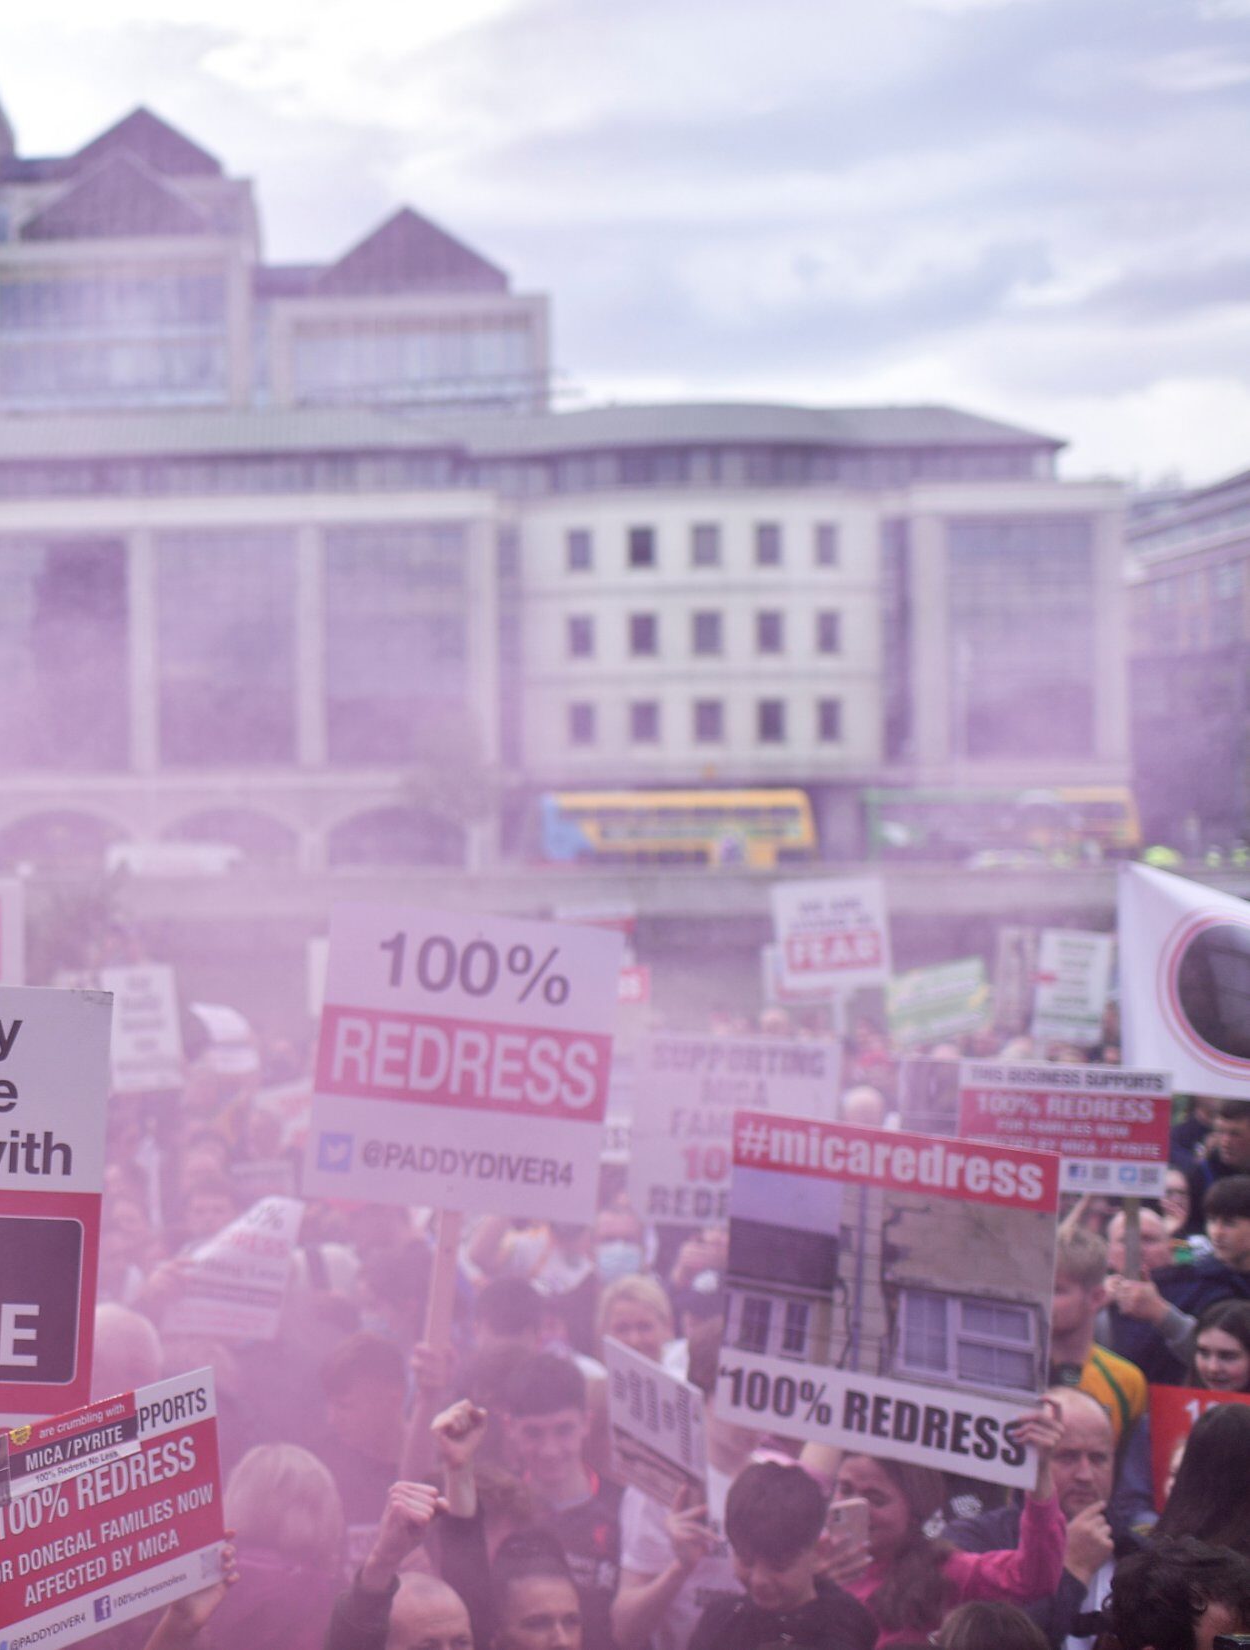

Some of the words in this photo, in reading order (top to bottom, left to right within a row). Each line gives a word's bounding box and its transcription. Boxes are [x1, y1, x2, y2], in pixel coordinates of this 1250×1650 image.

[379, 931, 571, 1006] 100%
[330, 1015, 600, 1110] REDRESS
[1006, 1068, 1080, 1085] BUSINESS
[1085, 1071, 1164, 1090] SUPPORTS
[976, 1093, 1041, 1115] 100%
[1046, 1096, 1155, 1124] REDRESS
[361, 1139, 575, 1188] @PADDYDIVER4
[737, 1119, 1044, 1201] #micaredress
[38, 1426, 56, 1440] are
[57, 1413, 104, 1434] crumbling
[105, 1404, 127, 1419] with
[136, 1387, 208, 1433] PPORTS
[725, 1365, 833, 1427] 100%
[842, 1389, 1028, 1467] REDRESS
[25, 1448, 64, 1472] MICA
[74, 1425, 124, 1457] PYRITE
[35, 1470, 57, 1484] 100%
[57, 1461, 88, 1479] Redress
[88, 1456, 100, 1469] No
[101, 1450, 120, 1464] Less
[76, 1435, 197, 1512] REDRESS
[18, 1529, 97, 1576] DONEGAL
[99, 1499, 174, 1544] FAMILIES
[177, 1483, 214, 1515] NOW
[24, 1556, 107, 1608] AFFECTED
[111, 1544, 133, 1572] BY
[137, 1528, 180, 1562] MICA
[10, 1611, 87, 1650] @PADDYDIVER4
